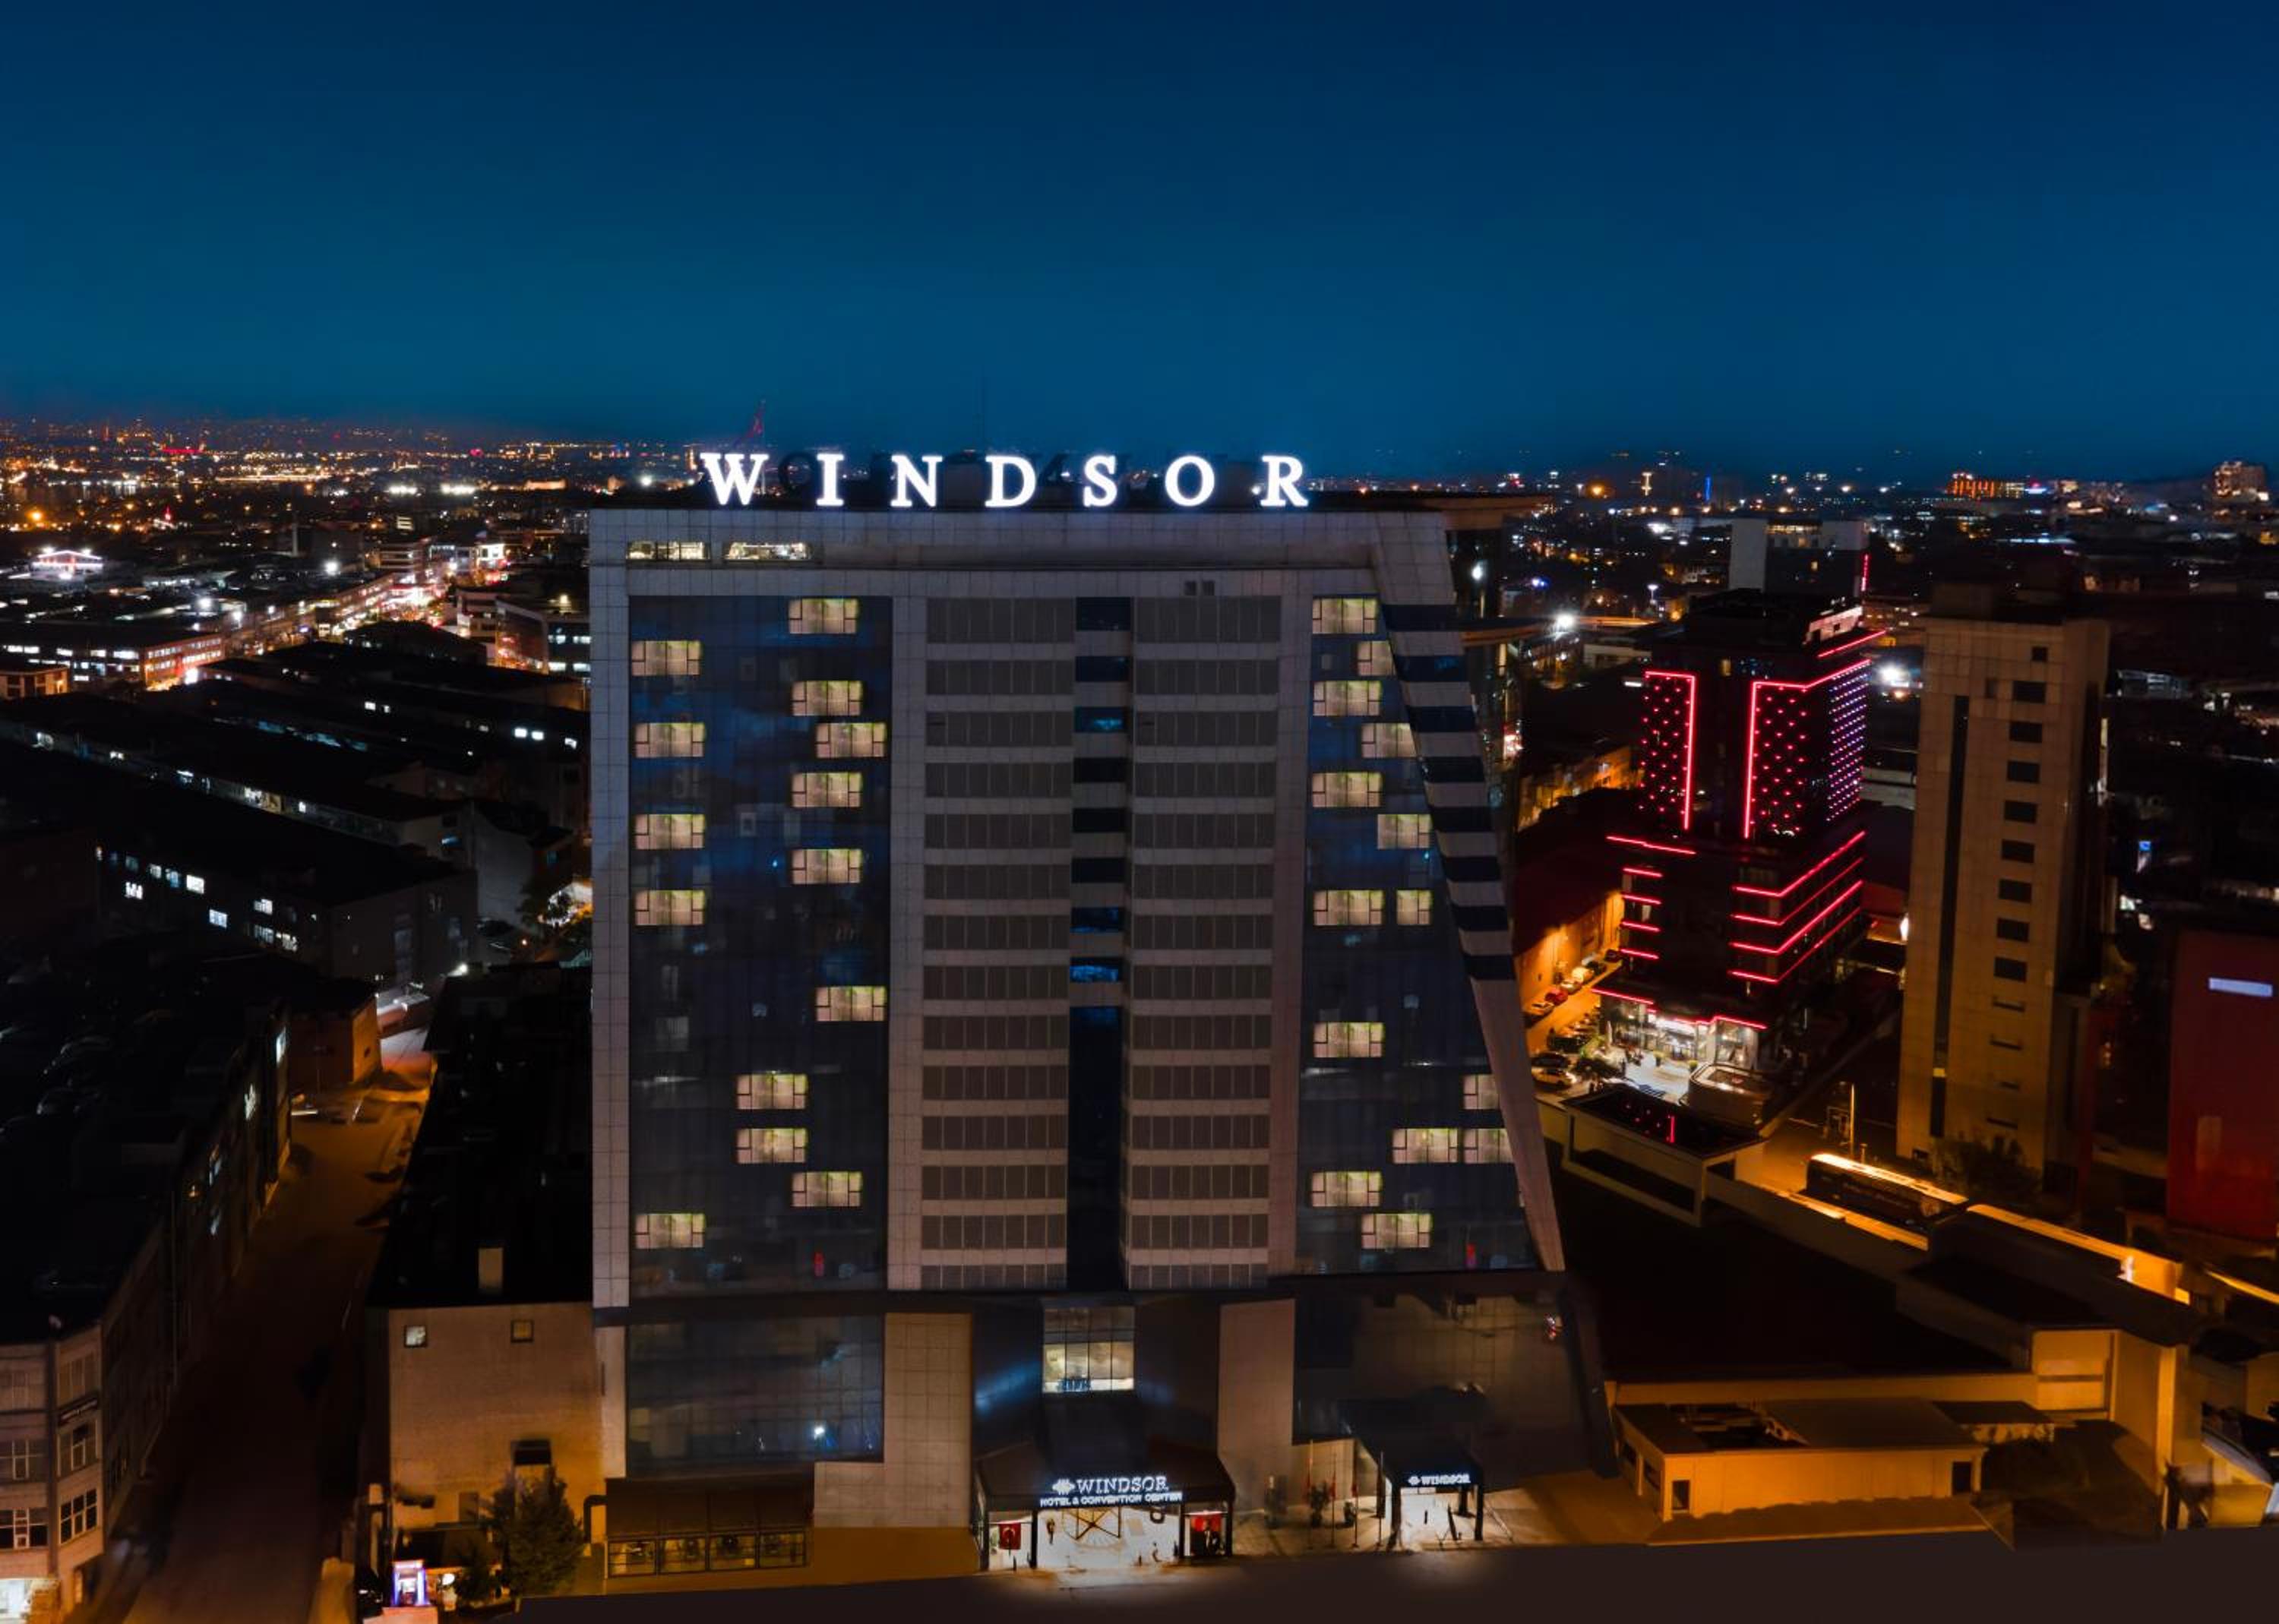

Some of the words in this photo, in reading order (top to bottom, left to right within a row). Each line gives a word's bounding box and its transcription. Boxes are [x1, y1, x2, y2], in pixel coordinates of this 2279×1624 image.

[700, 453, 1308, 507] WINDSOR
[1076, 1476, 1168, 1493] WINDSOR
[1421, 1473, 1471, 1484] WINDSOR
[1040, 1497, 1070, 1507] HOTEL
[1082, 1494, 1142, 1505] CONVENTION
[1145, 1492, 1182, 1502] CENTER
